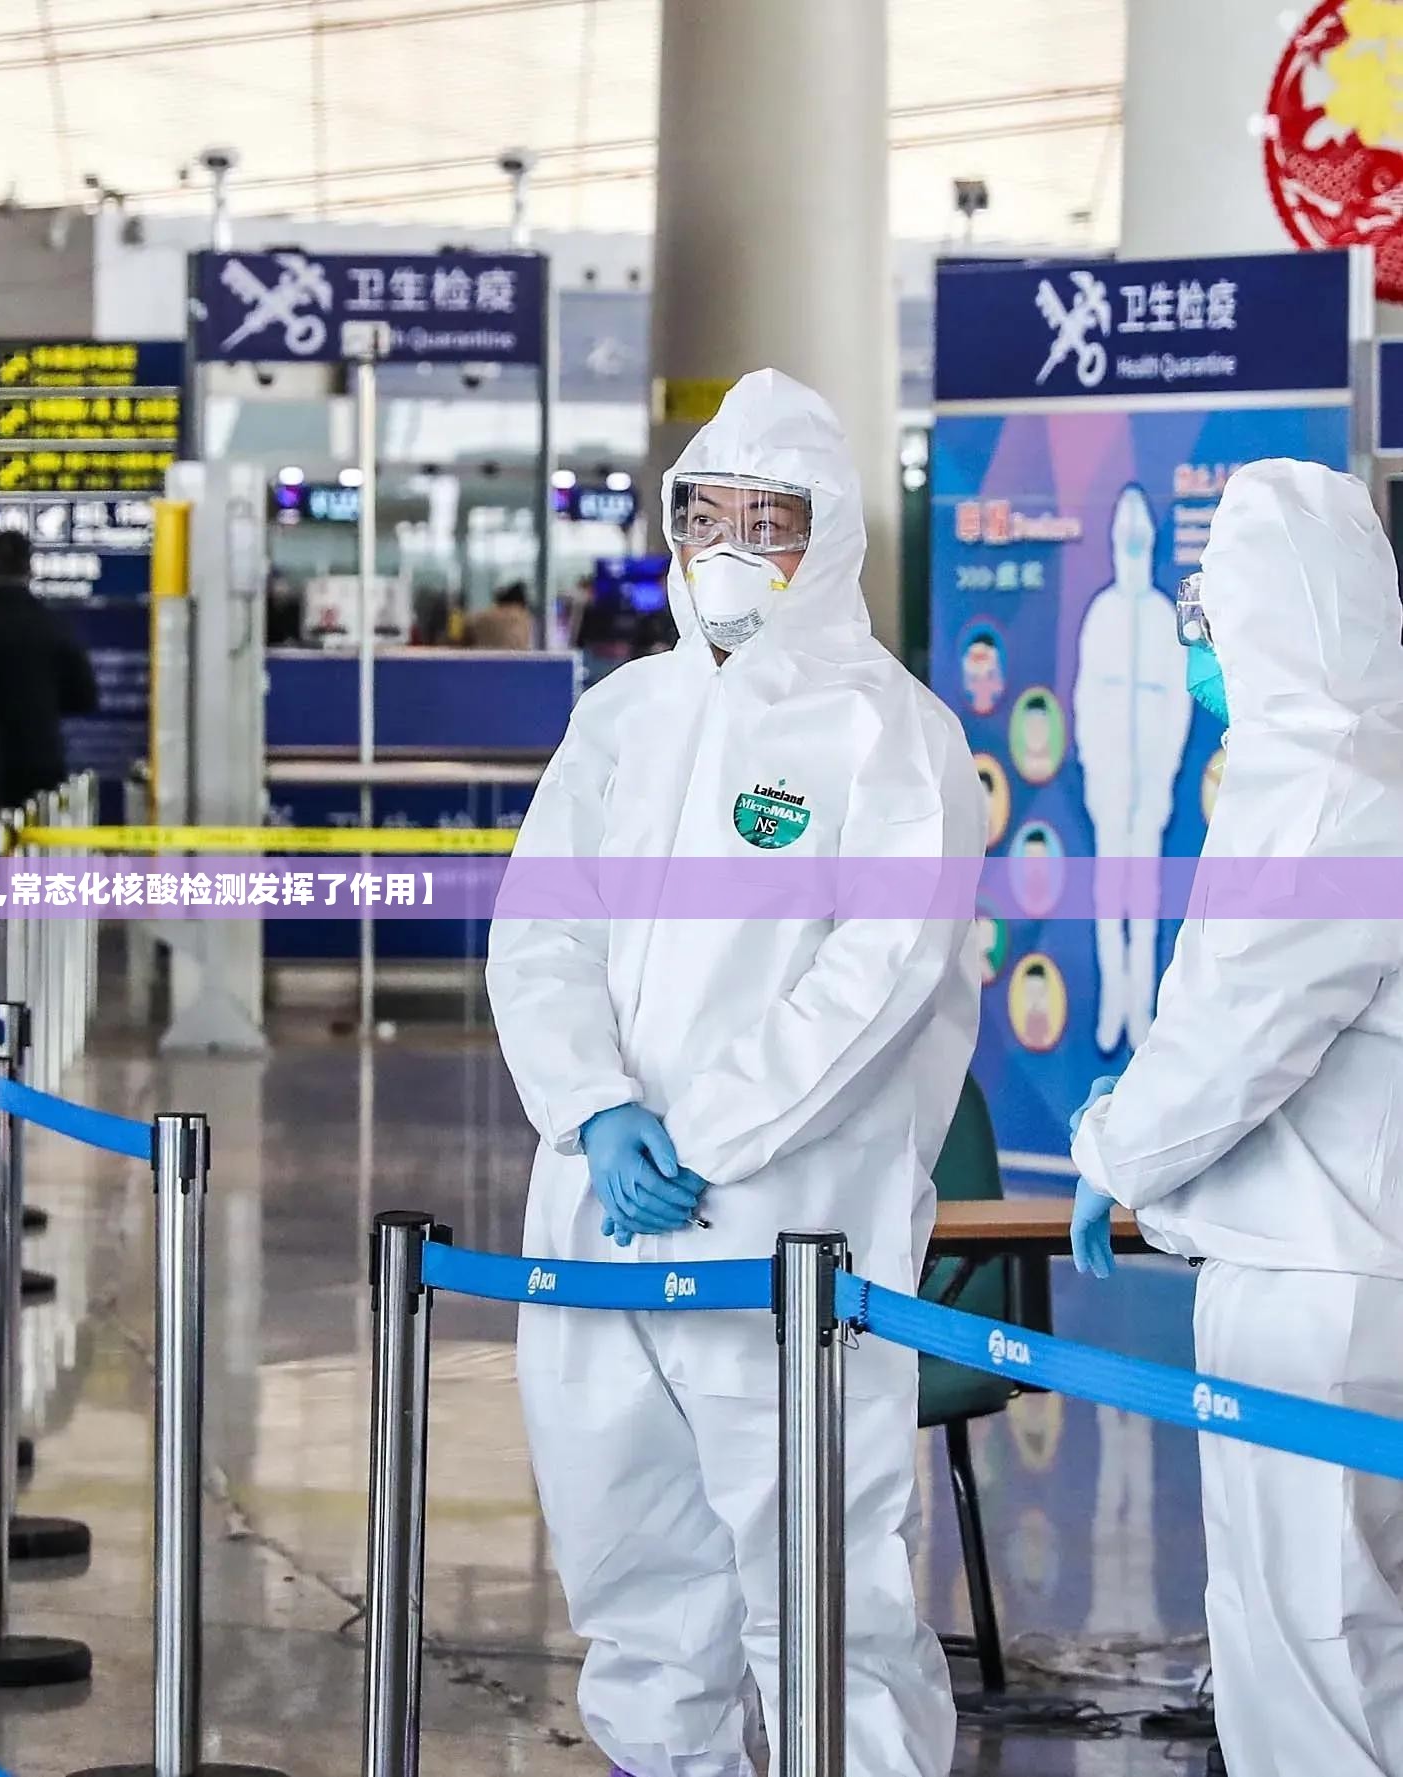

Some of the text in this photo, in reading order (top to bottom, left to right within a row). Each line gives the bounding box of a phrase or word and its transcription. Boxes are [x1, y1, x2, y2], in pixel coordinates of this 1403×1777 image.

[345, 266, 518, 313] 卫生检疫
[1118, 278, 1238, 333] 卫生检疫
[754, 784, 805, 806] Lakeland
[739, 797, 806, 825] MicroMAX
[755, 817, 777, 834] NS
